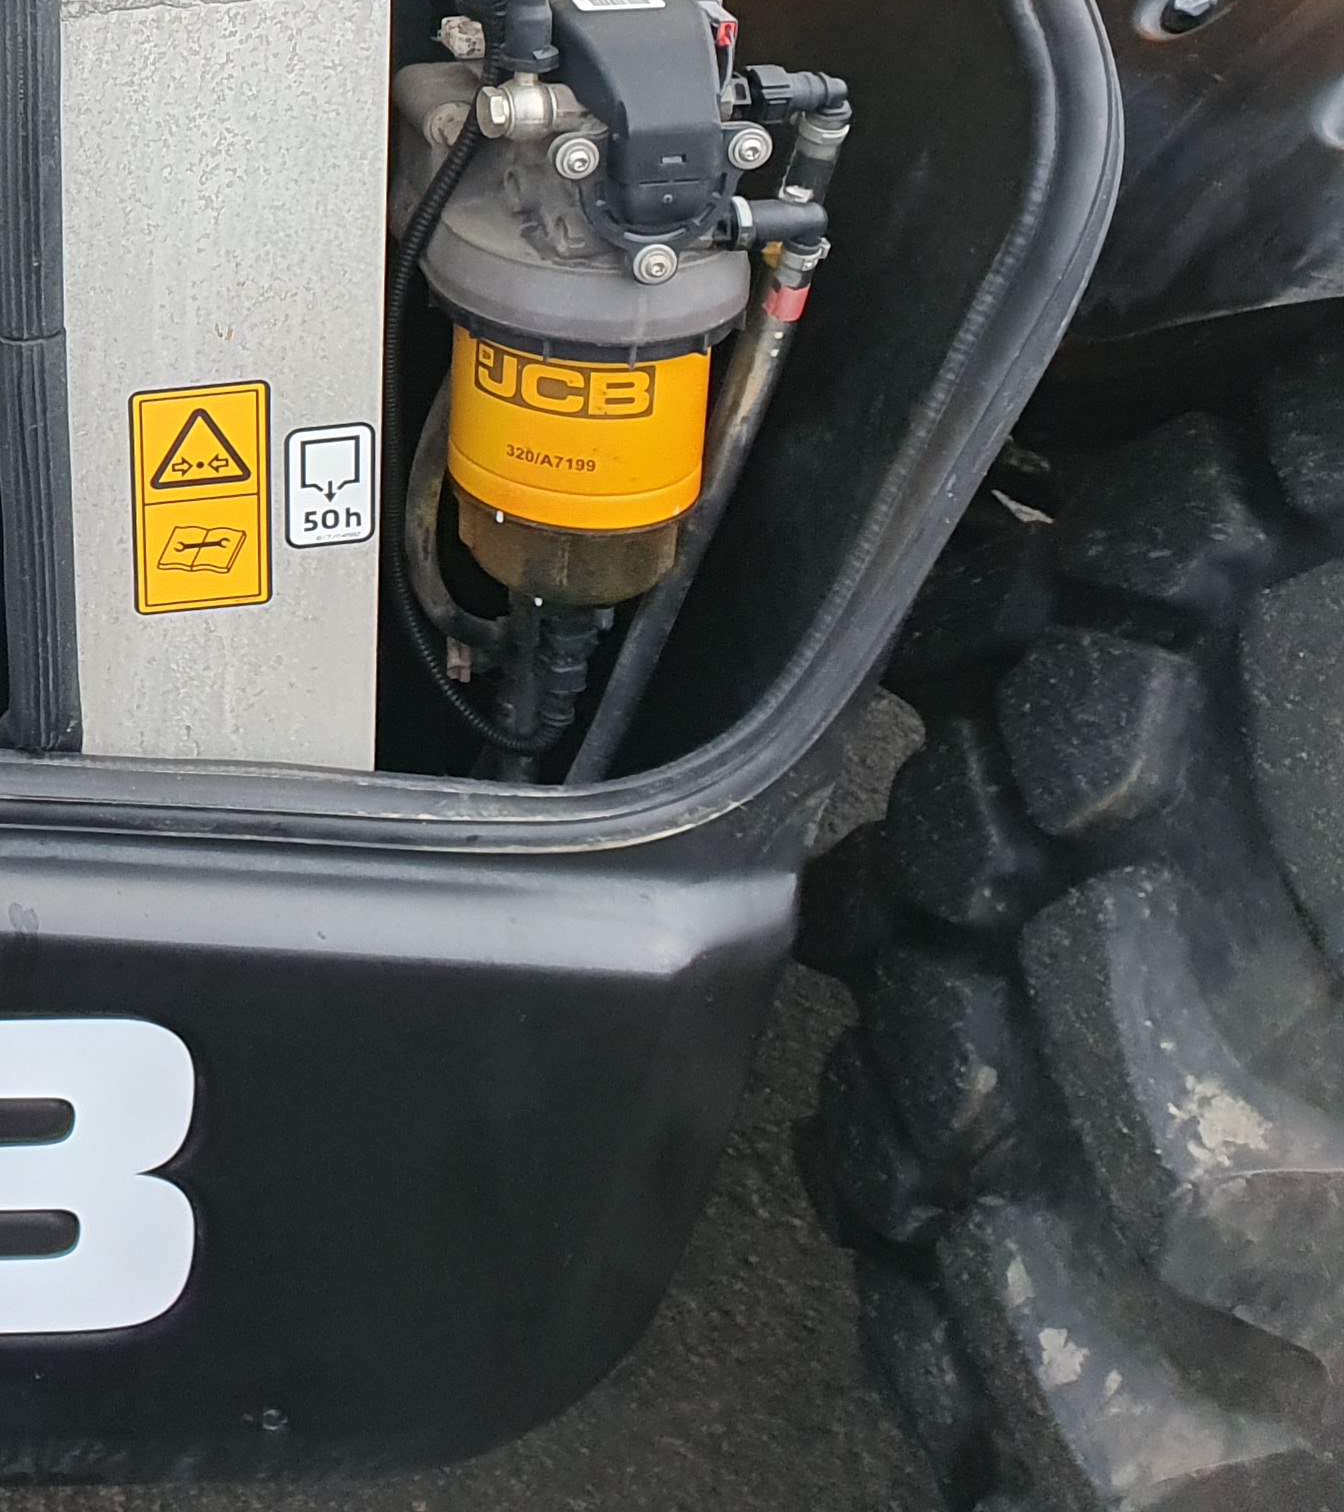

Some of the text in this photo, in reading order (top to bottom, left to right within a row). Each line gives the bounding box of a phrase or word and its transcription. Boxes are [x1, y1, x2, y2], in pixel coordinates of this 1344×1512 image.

[477, 343, 651, 416] JCB
[506, 443, 597, 473] 320/A7199
[303, 507, 362, 533] 50 h
